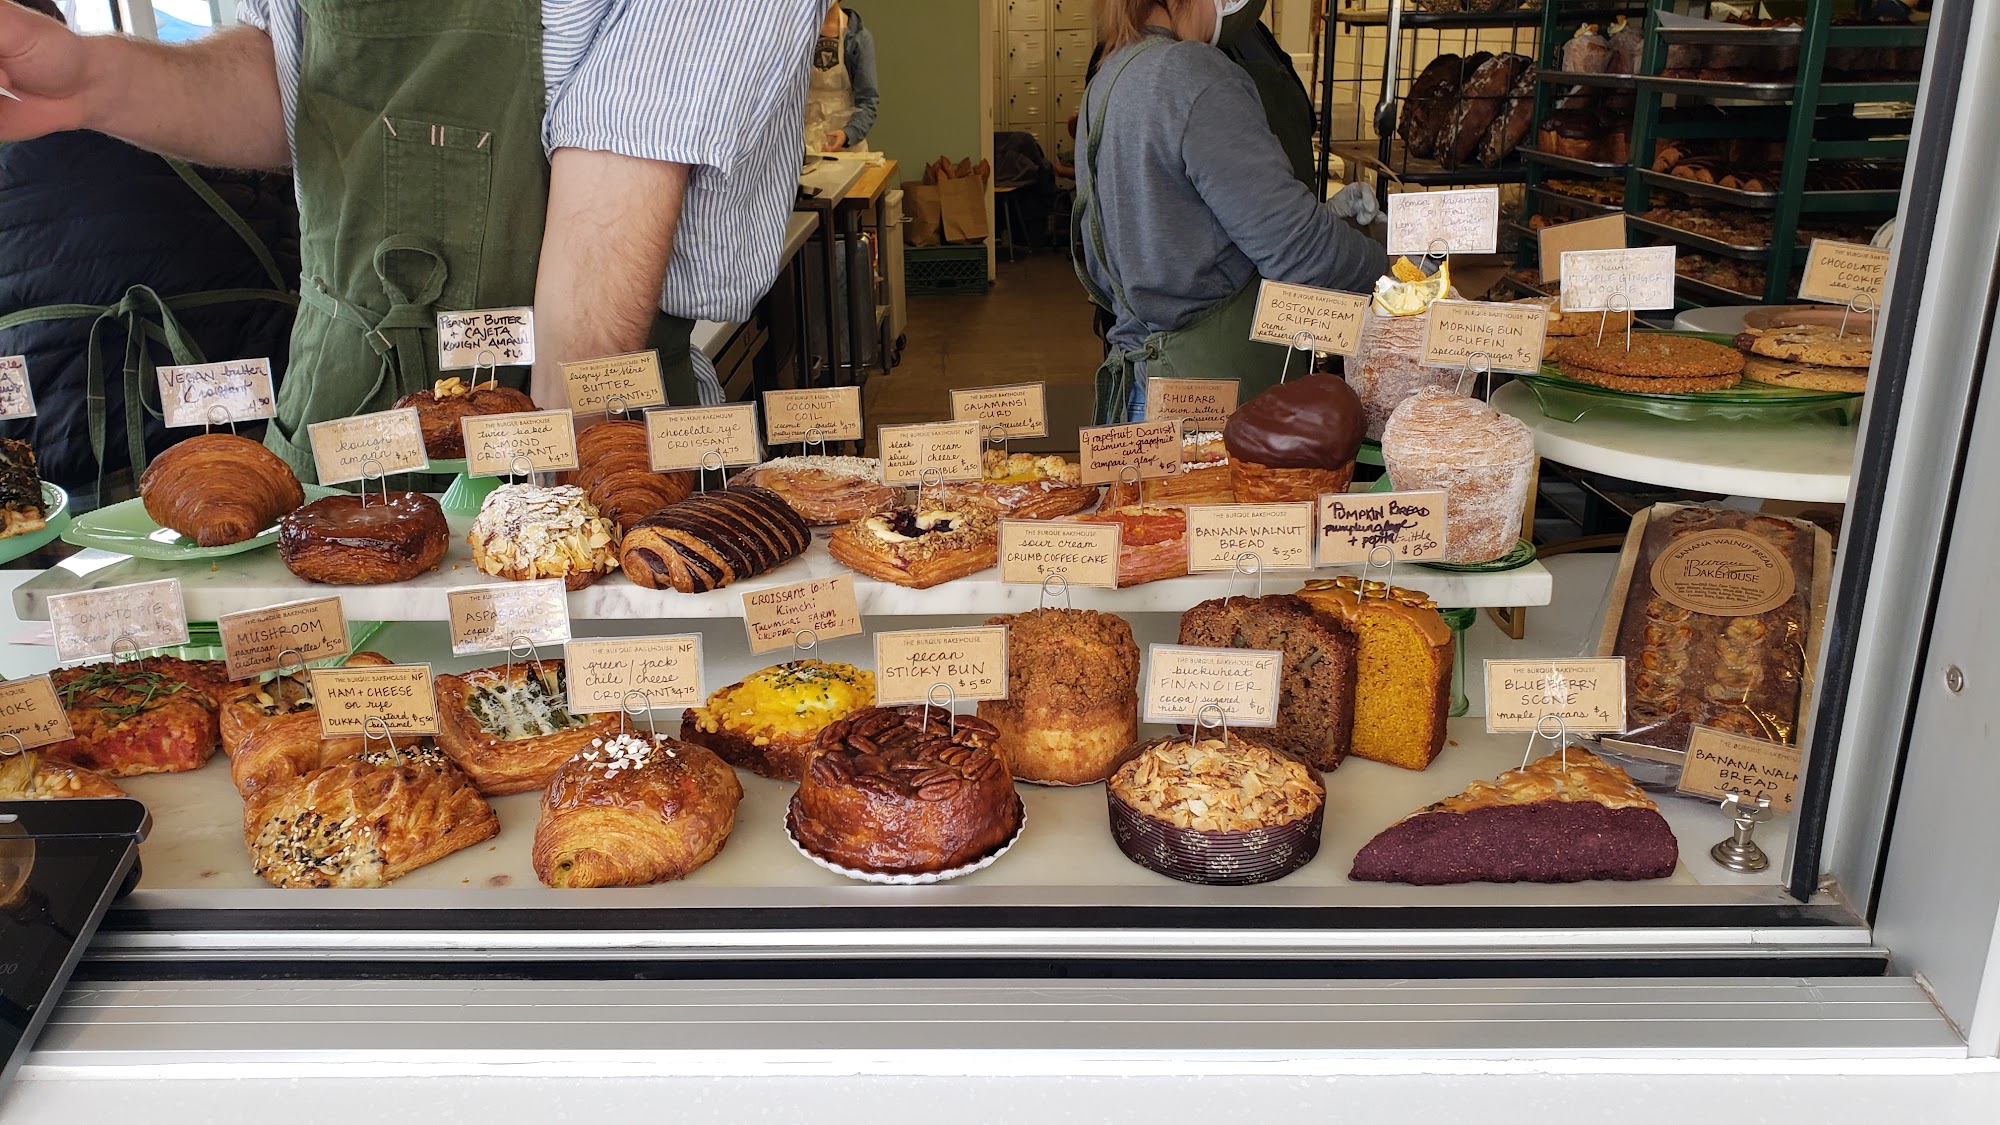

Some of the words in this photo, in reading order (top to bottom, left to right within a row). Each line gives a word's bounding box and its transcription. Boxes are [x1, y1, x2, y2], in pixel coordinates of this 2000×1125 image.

[1820, 256, 1882, 274] CHOCOLATE
[1838, 271, 1883, 285] COOKIE
[1271, 298, 1316, 316] BOSTON
[1317, 307, 1354, 322] CREAM
[440, 315, 480, 329] PEANUT
[484, 314, 527, 326] BUTTER
[1277, 312, 1332, 330] CRUFFIN
[464, 326, 513, 341] CAJETA
[1439, 321, 1494, 336] MORNING
[1497, 325, 1523, 337] BUN
[443, 338, 481, 351] KOUIGN
[1448, 334, 1505, 348] CRUFFIN
[162, 369, 216, 387] VEGAN
[582, 379, 636, 393] BUTTER
[578, 390, 641, 407] CROISSANT
[786, 400, 836, 411] COCONUT
[964, 399, 1027, 411] CALAMANSI
[1163, 393, 1216, 404] RHUBARB
[795, 412, 823, 421] COIL
[979, 410, 1012, 419] CURD
[657, 425, 714, 439] chocolate
[716, 423, 741, 436] rye
[483, 438, 540, 450] ALMOND
[667, 436, 735, 449] CROISSANT
[476, 445, 557, 461] CROISSANT
[898, 469, 916, 477] OAT
[1195, 526, 1248, 537] BANANA
[1249, 525, 1306, 537] WALNUT
[1018, 539, 1055, 548] sour
[1057, 539, 1098, 549] cream
[1220, 539, 1265, 549] BREAD
[1007, 552, 1042, 562] CRUMB
[1043, 553, 1079, 563] COFFEE
[1080, 554, 1109, 564] CAKE
[1674, 541, 1711, 560] BANANA
[1713, 539, 1753, 550] WALNUT
[1751, 546, 1774, 569] BREAD
[465, 603, 544, 623] ASPARAGUS
[776, 598, 816, 615] Kimchi
[237, 618, 324, 646] MUSHROOM
[678, 643, 694, 653] NF
[583, 660, 628, 675] green
[638, 656, 679, 672] jack
[906, 651, 965, 666] pecan
[1255, 660, 1273, 670] GF
[411, 672, 424, 681] NF
[886, 665, 942, 678] STICKY
[948, 661, 985, 676] BUN
[1171, 665, 1253, 677] buckwheat
[636, 672, 679, 684] cheese
[1161, 677, 1262, 692] FINANCIER
[1504, 678, 1598, 691] BLUEBERRY
[327, 687, 354, 699] HAM
[366, 685, 414, 697] CHEESE
[1521, 692, 1579, 706] SCONE
[344, 701, 362, 710] on
[365, 700, 393, 713] rye
[1159, 695, 1194, 704] cocoa
[328, 717, 363, 727] DUKKA
[1496, 710, 1536, 722] maple
[1696, 749, 1758, 773] BANANA
[1719, 769, 1778, 790] BREAD
